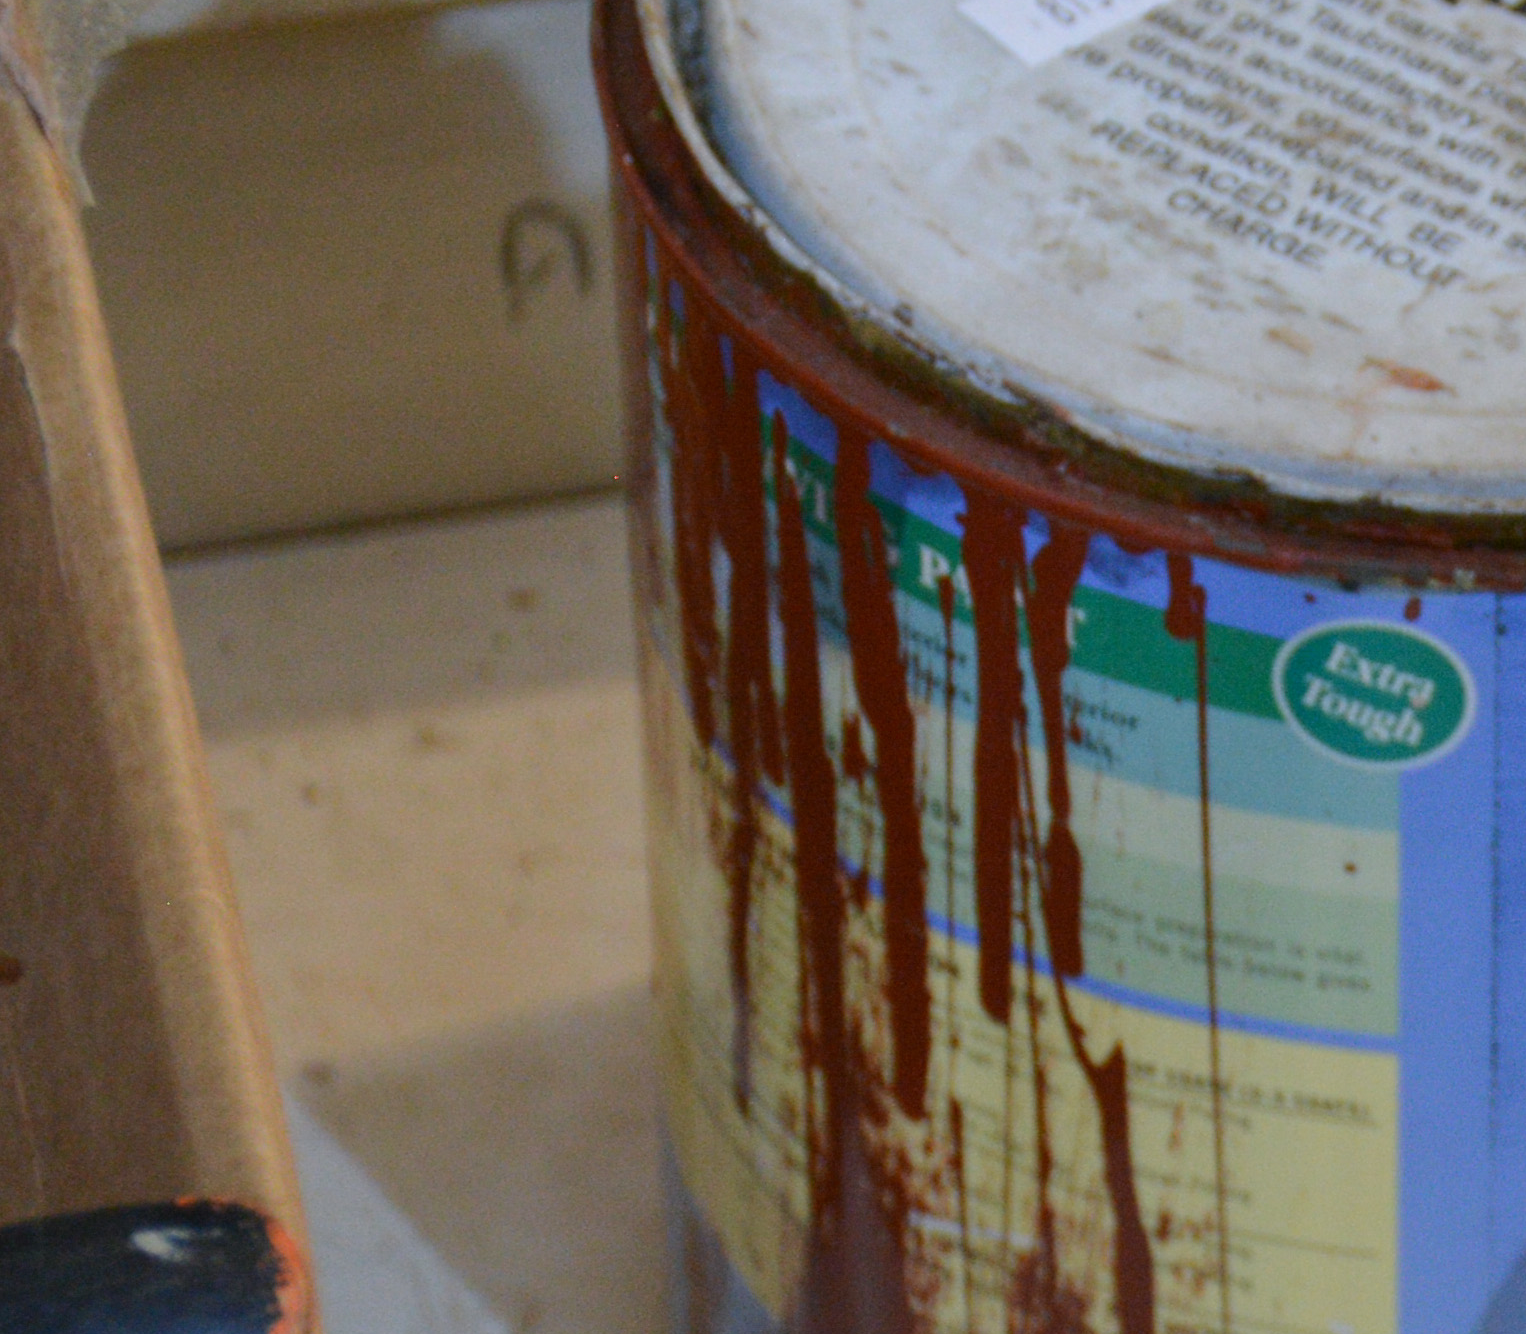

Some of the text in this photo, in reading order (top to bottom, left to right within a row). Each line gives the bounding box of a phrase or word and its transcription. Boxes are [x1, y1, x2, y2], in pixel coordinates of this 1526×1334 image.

[1090, 117, 1291, 217] REPLACED
[1167, 187, 1331, 267] CHARGE
[1302, 671, 1424, 748] Tough
[1325, 640, 1435, 708] Extra
